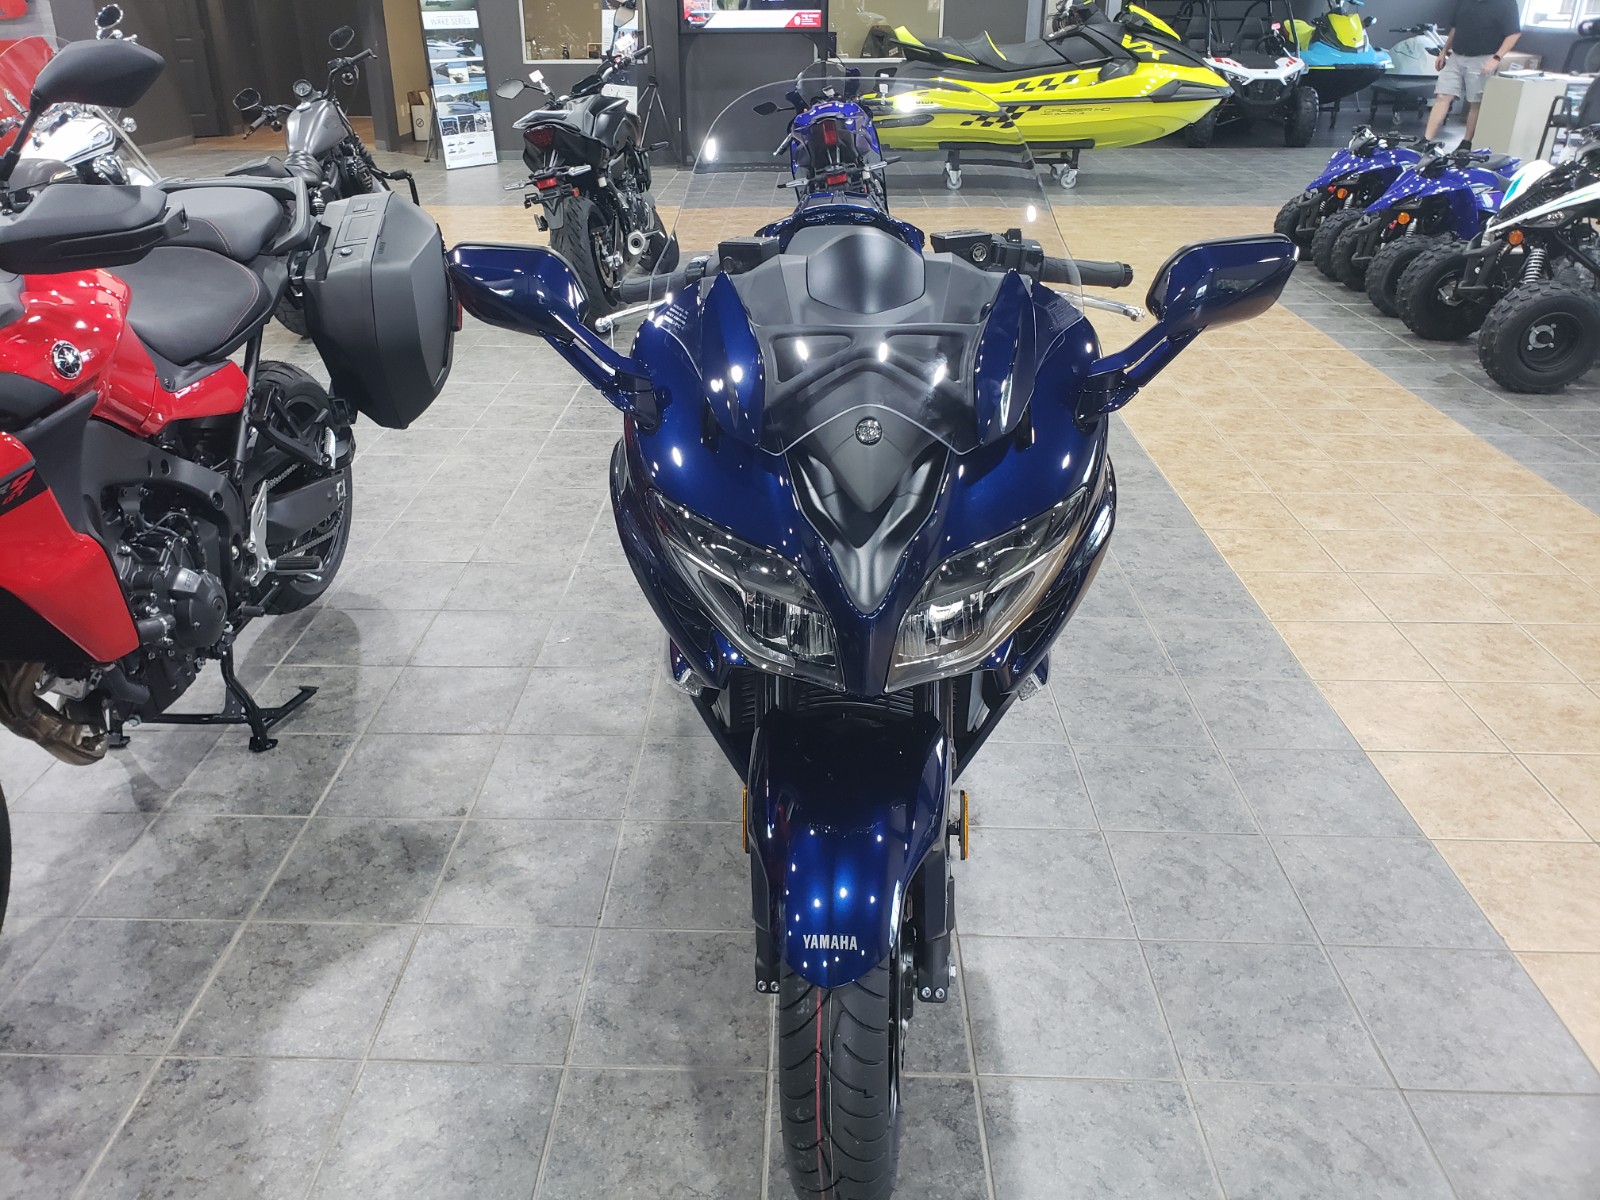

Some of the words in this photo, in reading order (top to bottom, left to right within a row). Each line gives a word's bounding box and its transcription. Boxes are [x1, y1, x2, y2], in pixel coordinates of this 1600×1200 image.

[430, 17, 449, 26] WAKE
[451, 17, 471, 26] SERIES
[1121, 34, 1169, 60] VX
[802, 934, 858, 951] YAMAHA
